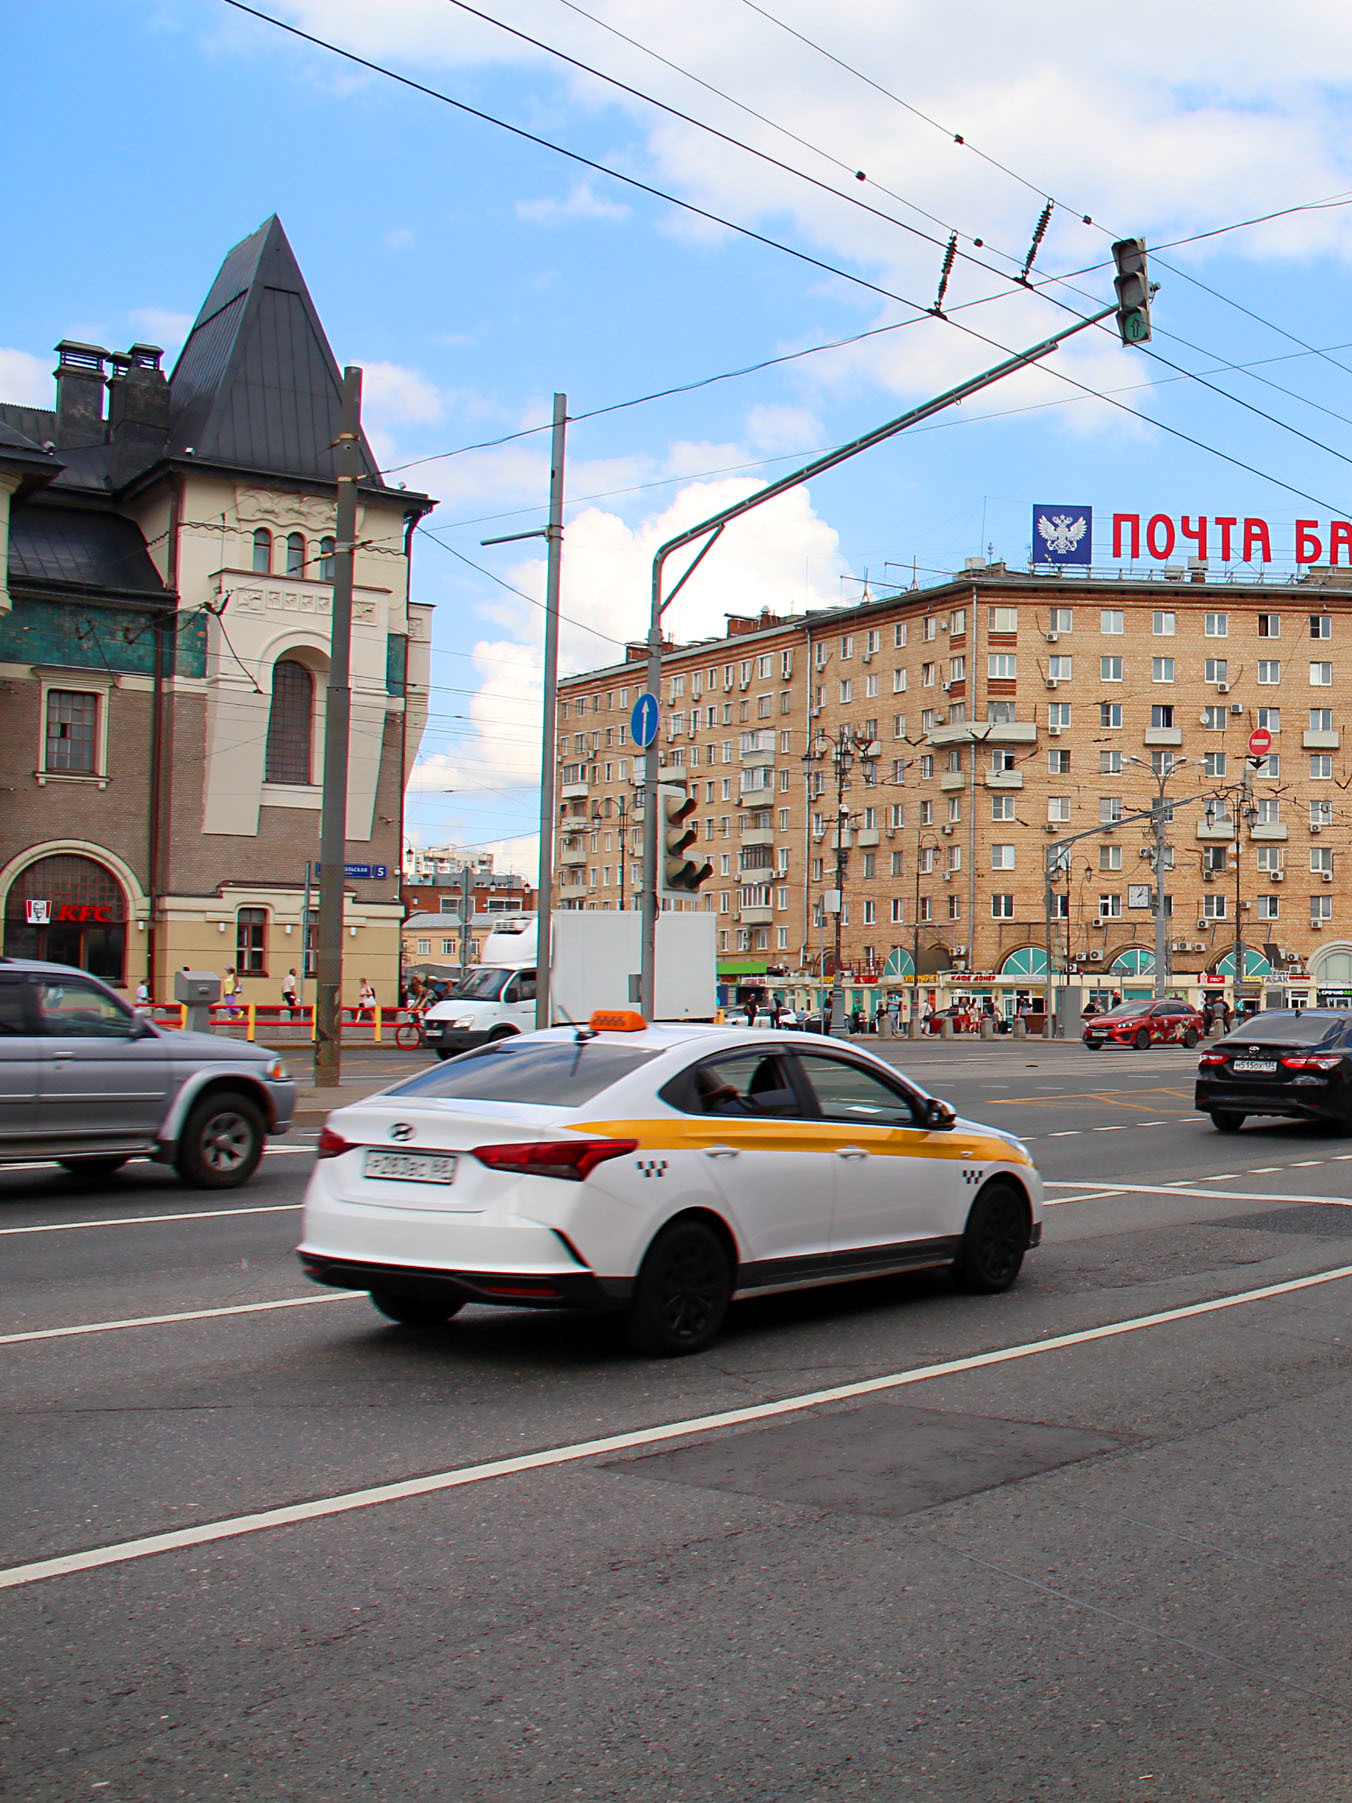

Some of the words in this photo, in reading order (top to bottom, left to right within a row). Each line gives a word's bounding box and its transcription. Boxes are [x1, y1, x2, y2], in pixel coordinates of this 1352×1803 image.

[1112, 513, 1272, 562] ПОЧТА
[377, 867, 385, 877] 5
[57, 905, 112, 922] KFC
